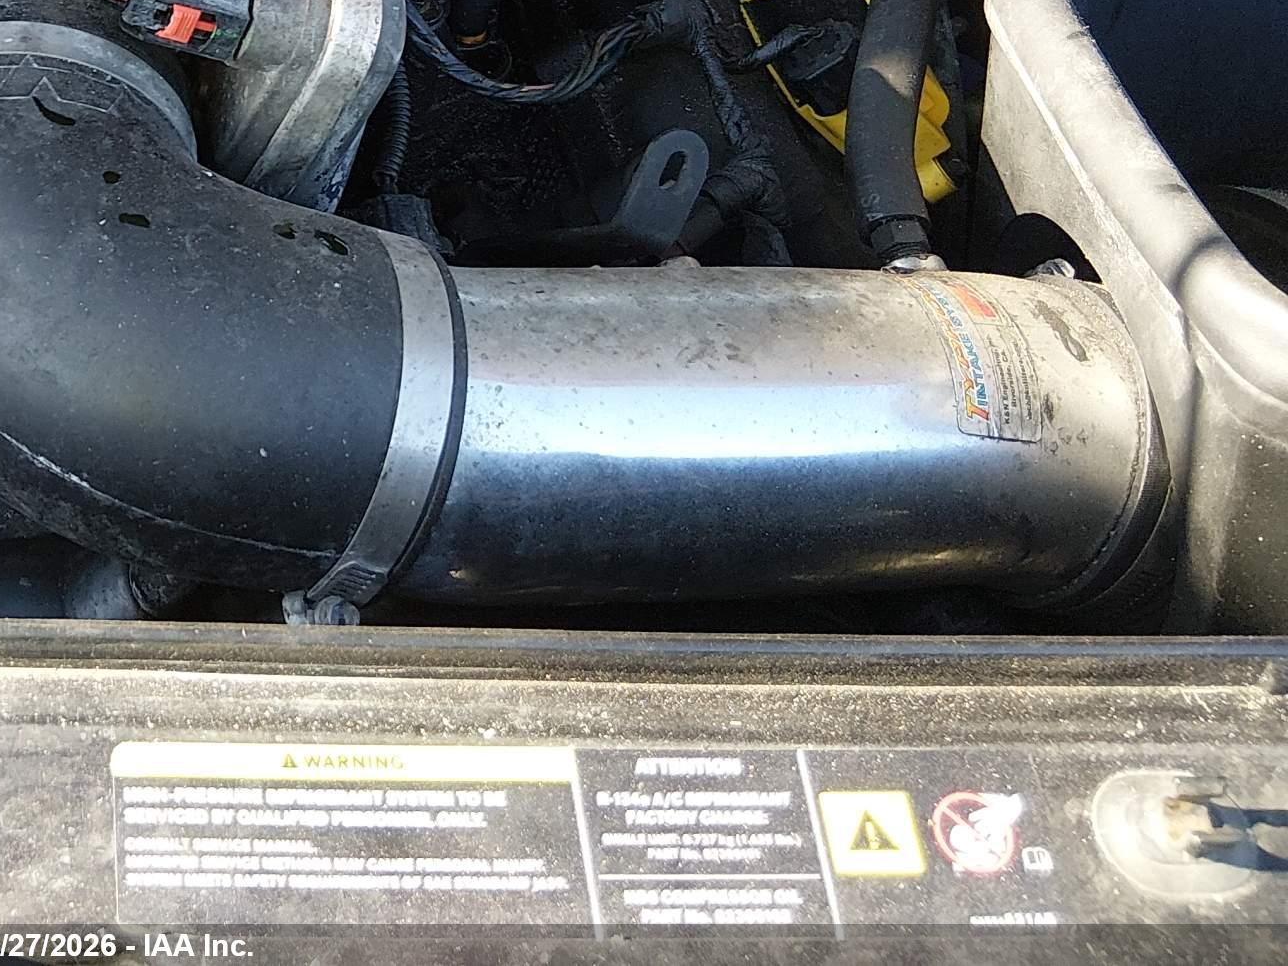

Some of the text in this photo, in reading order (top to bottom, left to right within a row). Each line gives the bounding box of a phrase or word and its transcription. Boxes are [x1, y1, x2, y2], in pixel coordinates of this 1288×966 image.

[959, 333, 988, 406] INTAKE
[304, 754, 403, 769] WARNING
[635, 757, 743, 775] ATTENTION
[625, 809, 699, 826] FACTORY
